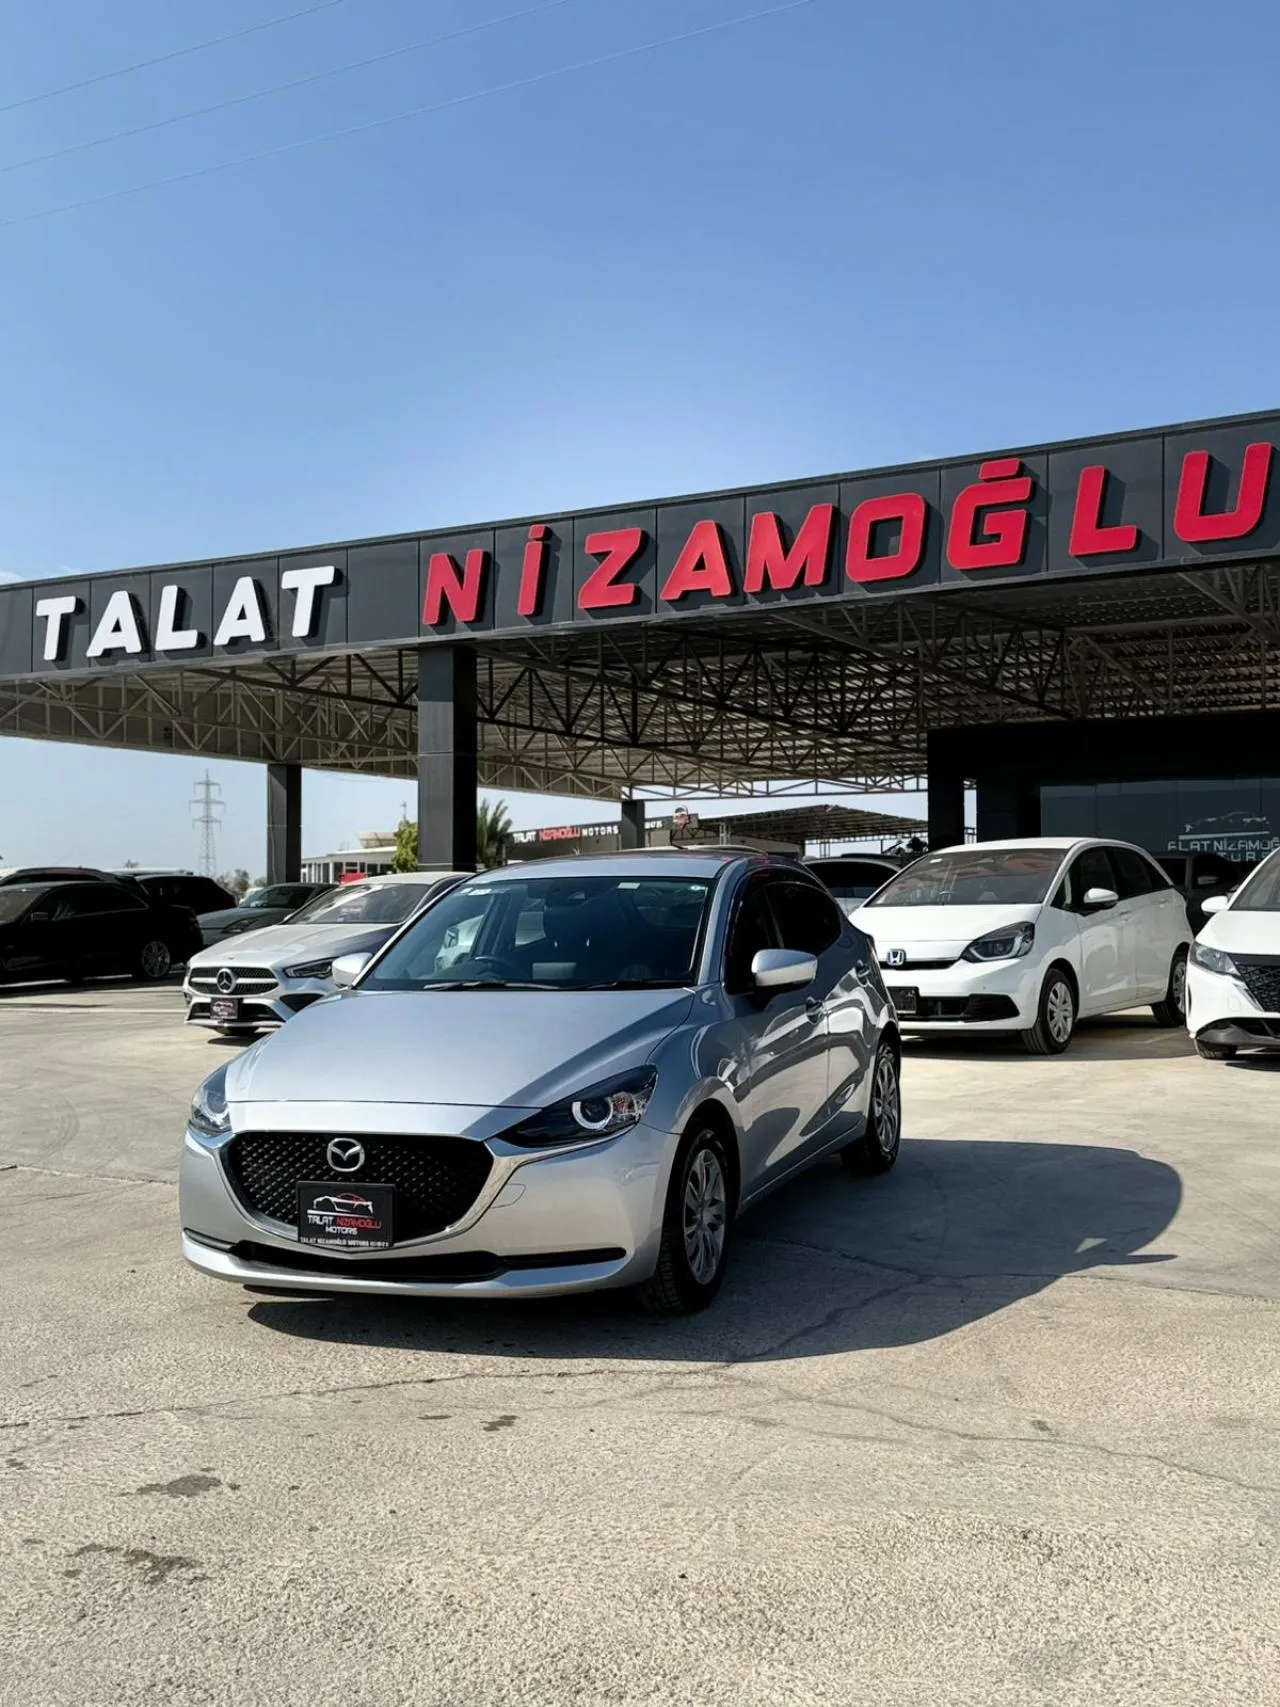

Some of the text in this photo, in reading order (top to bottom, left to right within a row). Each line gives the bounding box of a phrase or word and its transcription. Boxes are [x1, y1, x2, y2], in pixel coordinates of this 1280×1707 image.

[36, 442, 1272, 660] TALAT NİZAMOĞLU
[582, 825, 619, 836] MOTORS
[307, 1215, 334, 1225] TALAT
[325, 1226, 358, 1235] MOTORS
